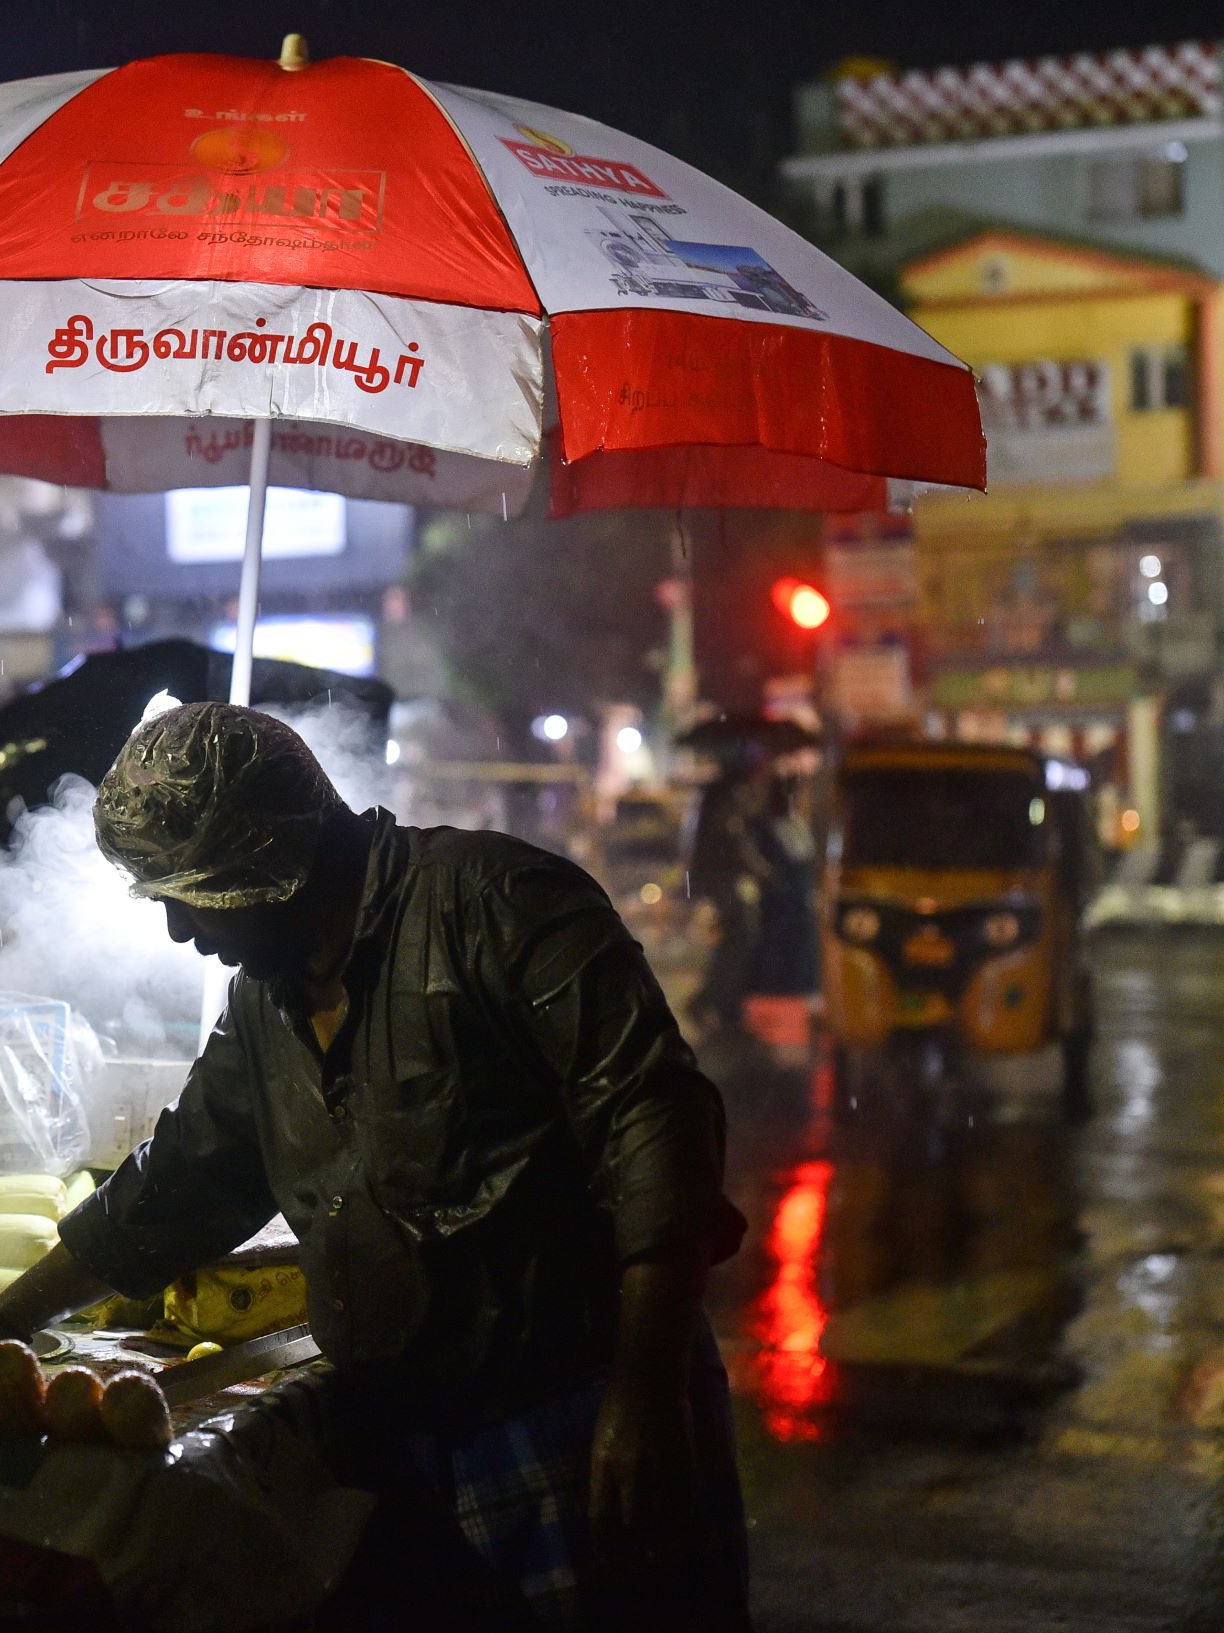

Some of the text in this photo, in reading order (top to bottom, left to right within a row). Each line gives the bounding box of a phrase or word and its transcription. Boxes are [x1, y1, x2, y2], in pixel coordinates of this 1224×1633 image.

[183, 107, 307, 122] உங்கள்
[516, 148, 651, 189] SATHYA
[544, 185, 688, 216] SPREADING HAPPINESS
[45, 314, 425, 394] திருவான்மியூர்
